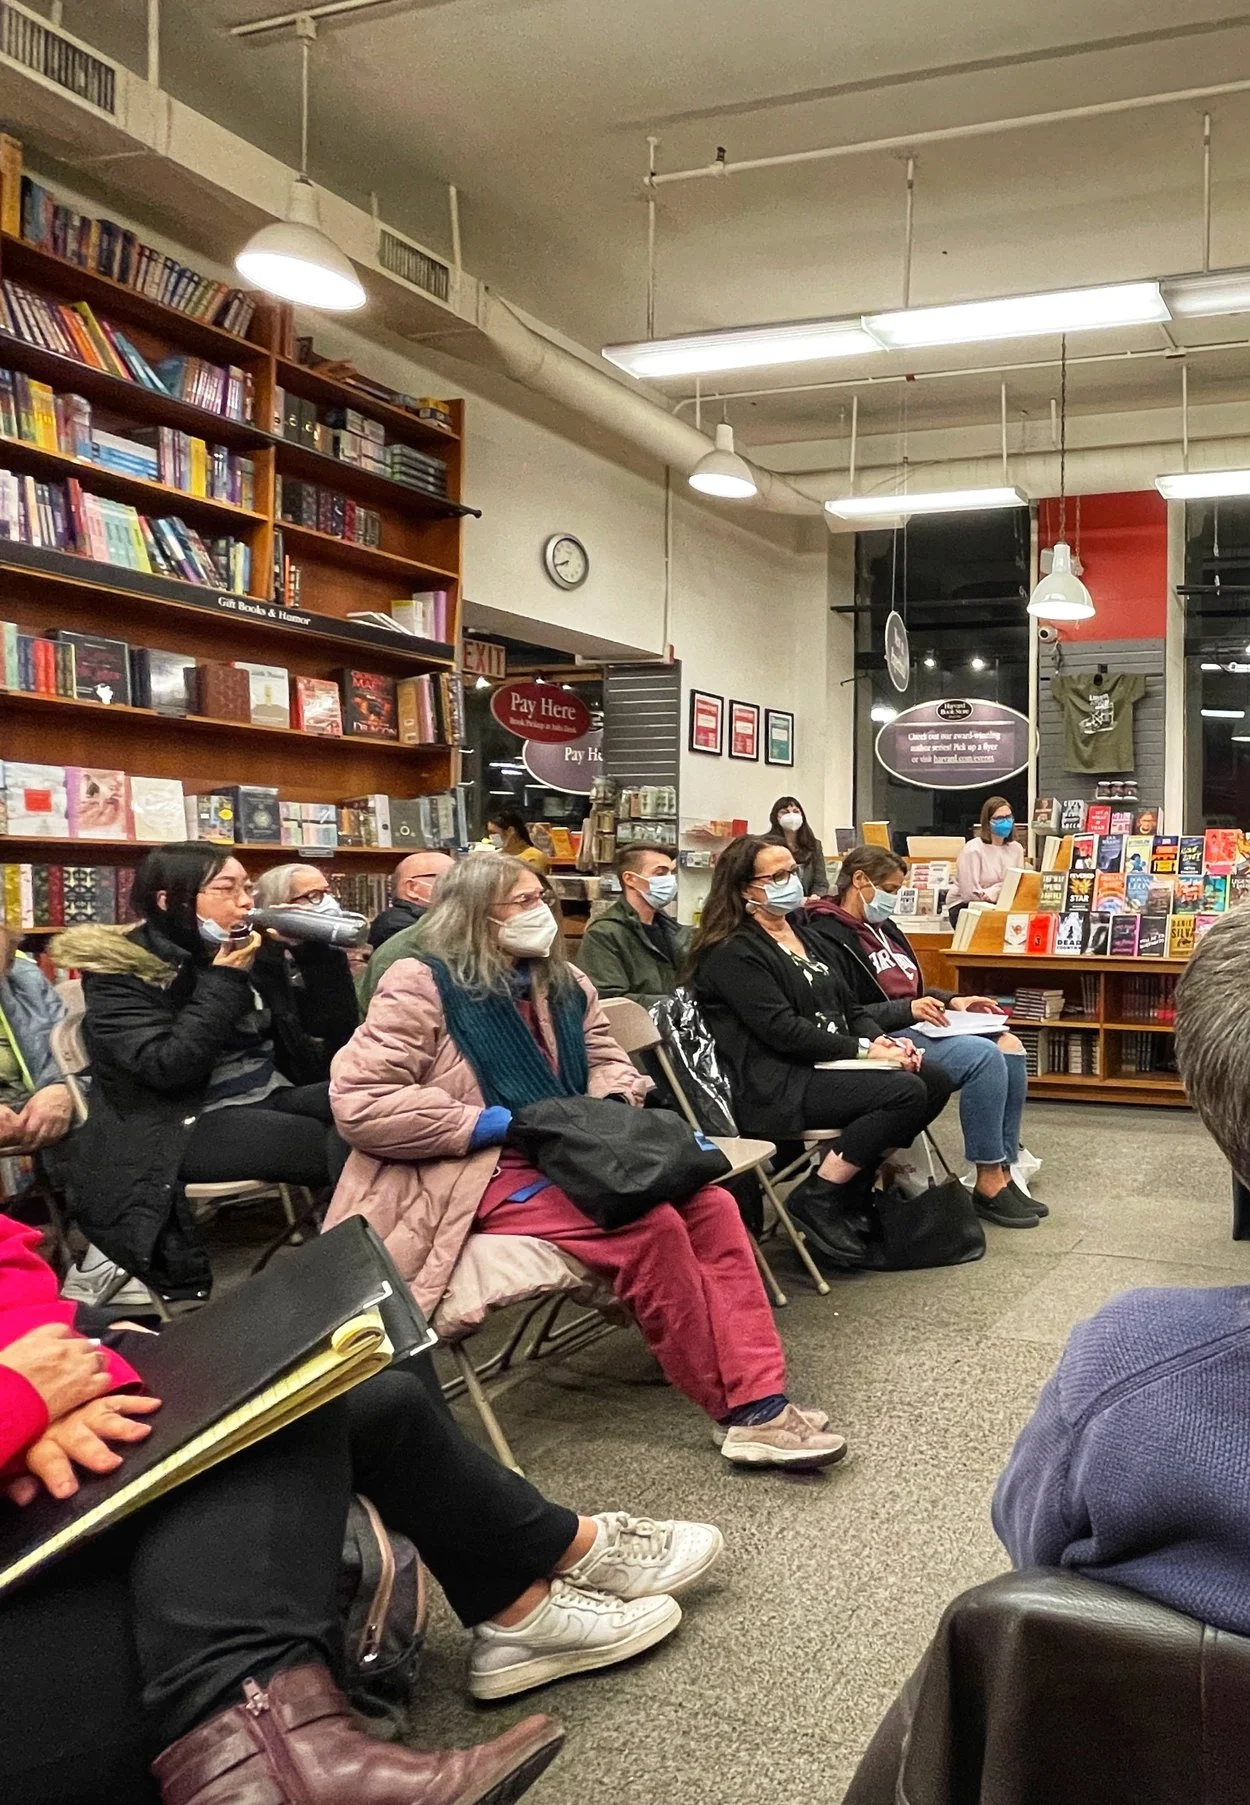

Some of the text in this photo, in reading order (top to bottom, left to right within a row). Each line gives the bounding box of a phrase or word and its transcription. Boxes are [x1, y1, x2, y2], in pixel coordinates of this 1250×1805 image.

[218, 596, 311, 625] Gift Books & Humor
[463, 640, 504, 676] EXIT
[510, 691, 577, 721] Pay Here
[943, 702, 966, 710] Harvard
[940, 708, 955, 716] Book
[908, 732, 927, 741] Check
[927, 732, 940, 741] out
[953, 731, 1001, 741] award-winning
[910, 743, 931, 752] author
[953, 742, 966, 751] Pick
[967, 744, 977, 753] up
[982, 742, 998, 752] flyer
[564, 746, 585, 765] Pay
[919, 754, 933, 763] visit
[1069, 872, 1095, 880] FEVERED
[1069, 894, 1090, 903] STAR
